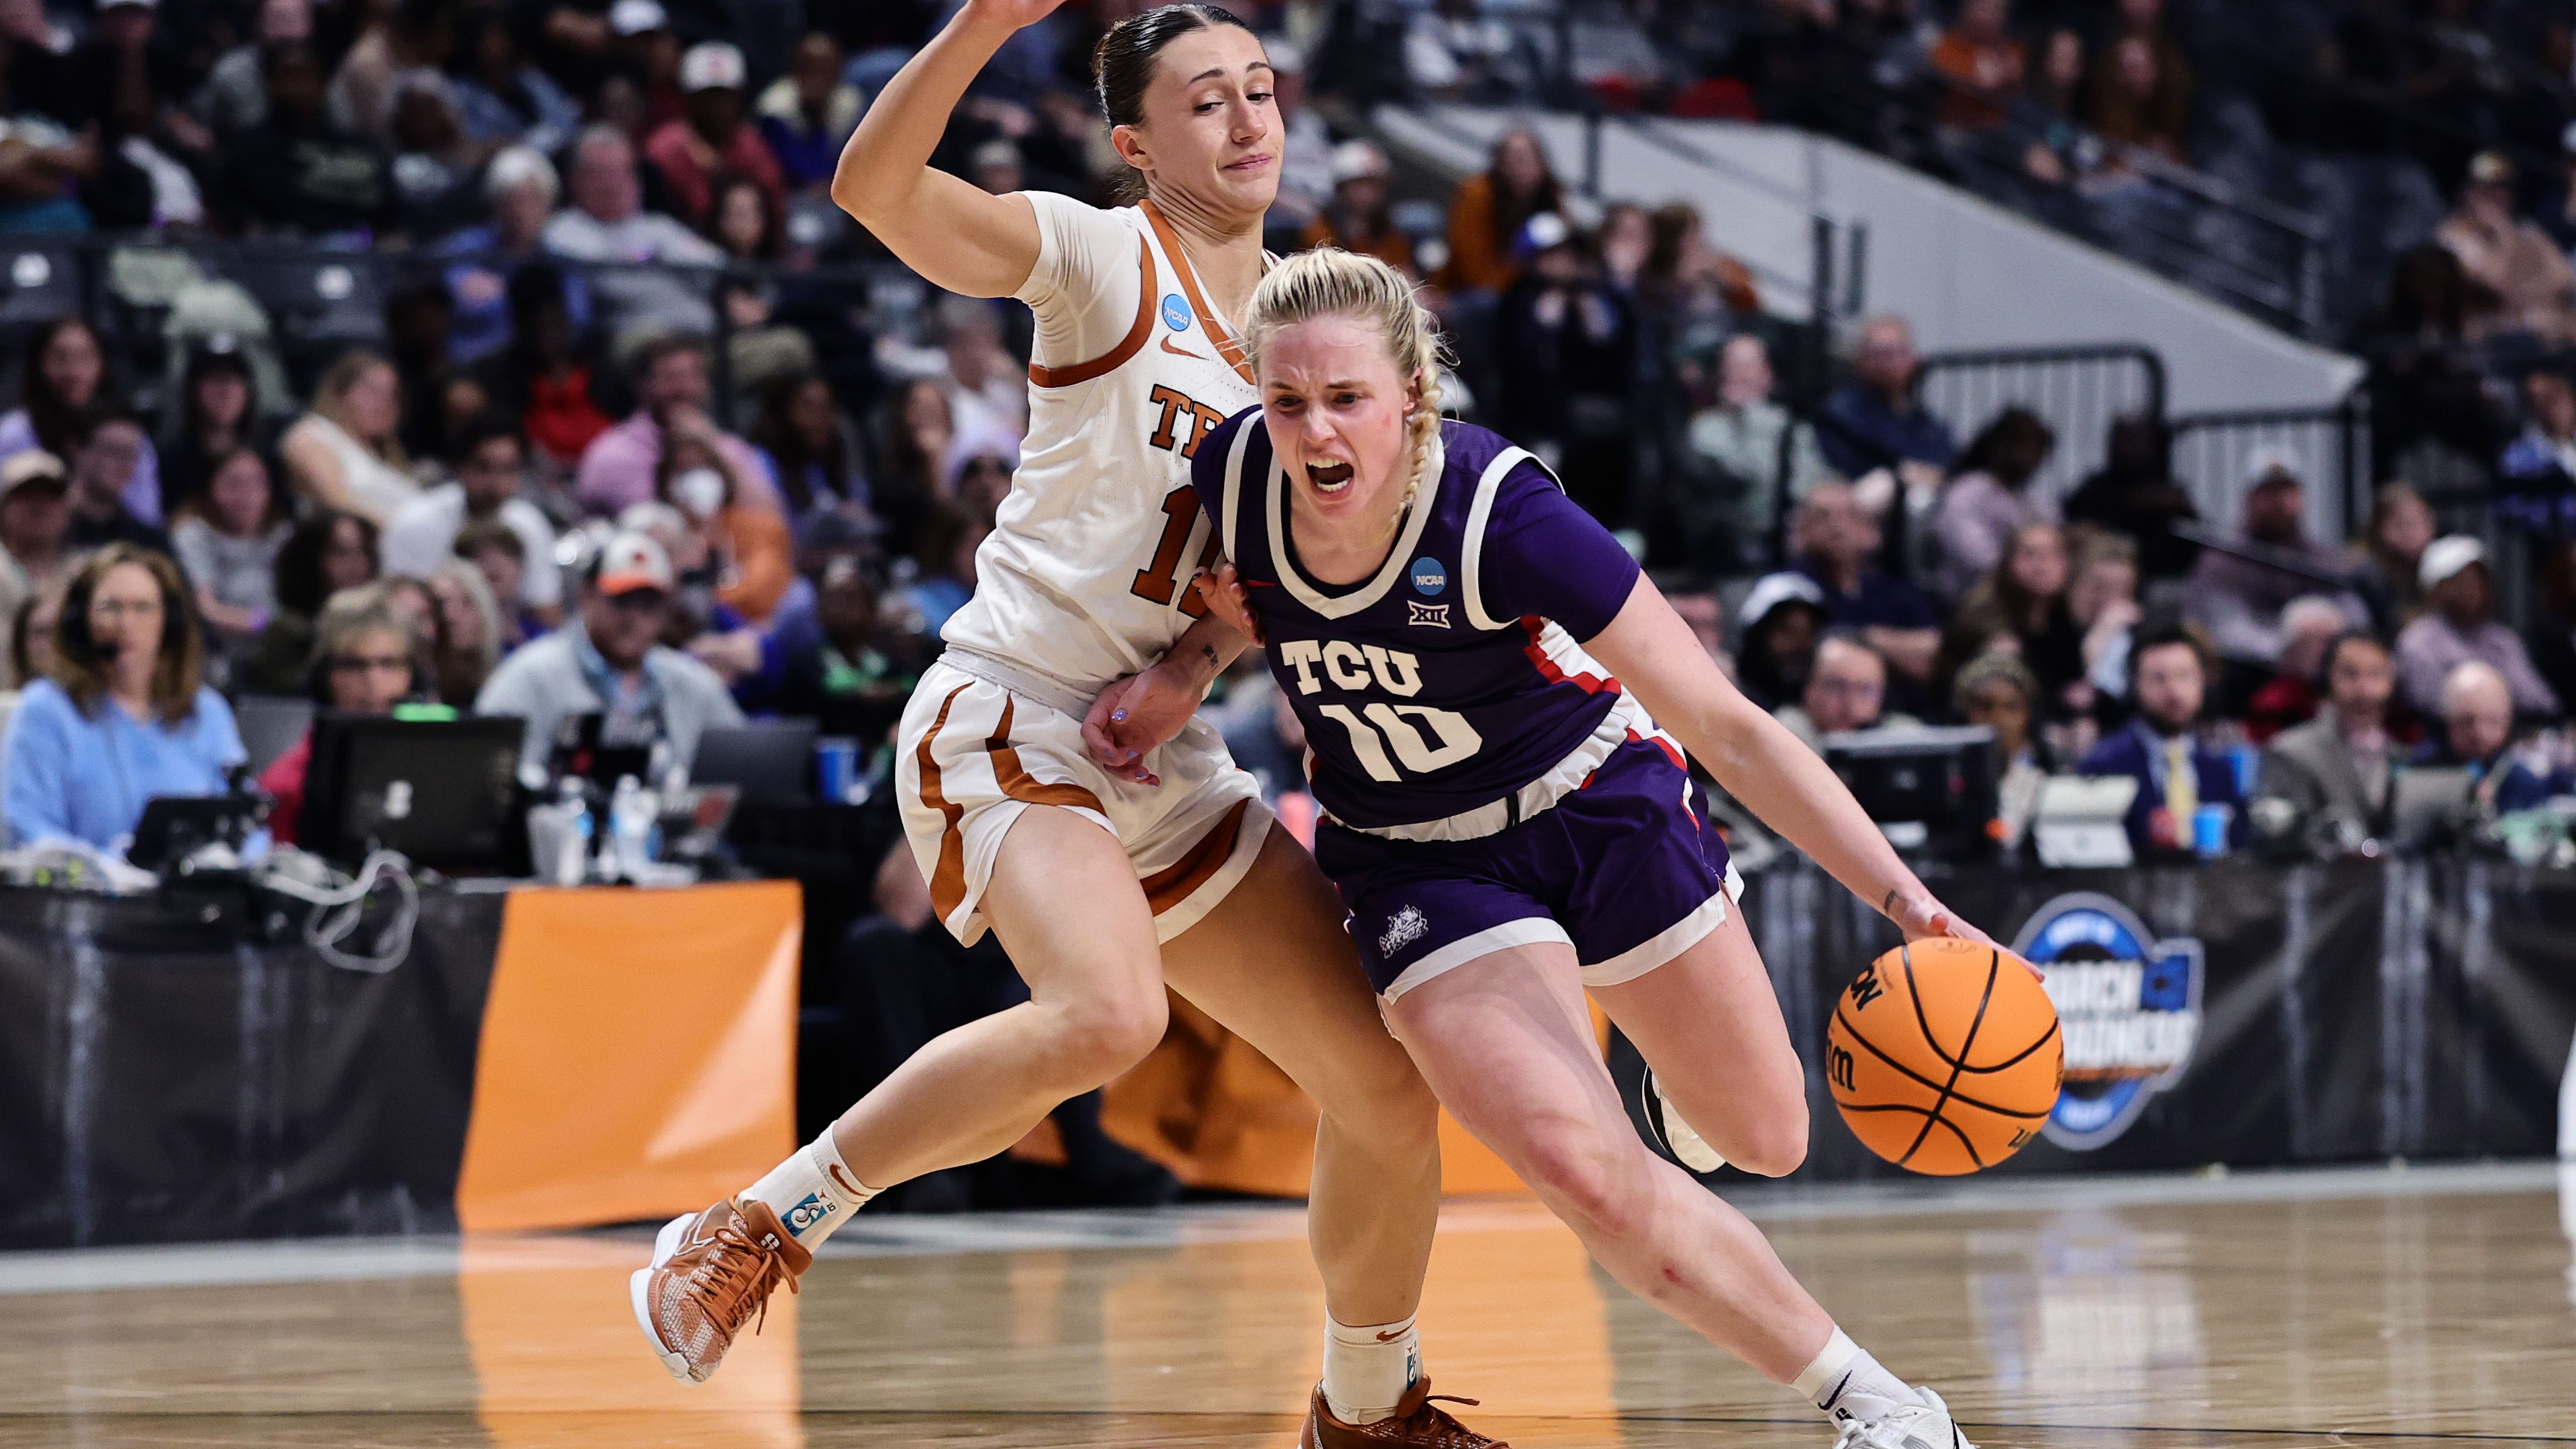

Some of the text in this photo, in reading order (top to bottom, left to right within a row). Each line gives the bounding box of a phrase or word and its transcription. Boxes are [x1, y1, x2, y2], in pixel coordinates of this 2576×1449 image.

[1165, 306, 1190, 326] NCAA
[1415, 575, 1444, 586] NCAA
[1280, 639, 1423, 698] TCU
[1318, 702, 1483, 782] 10
